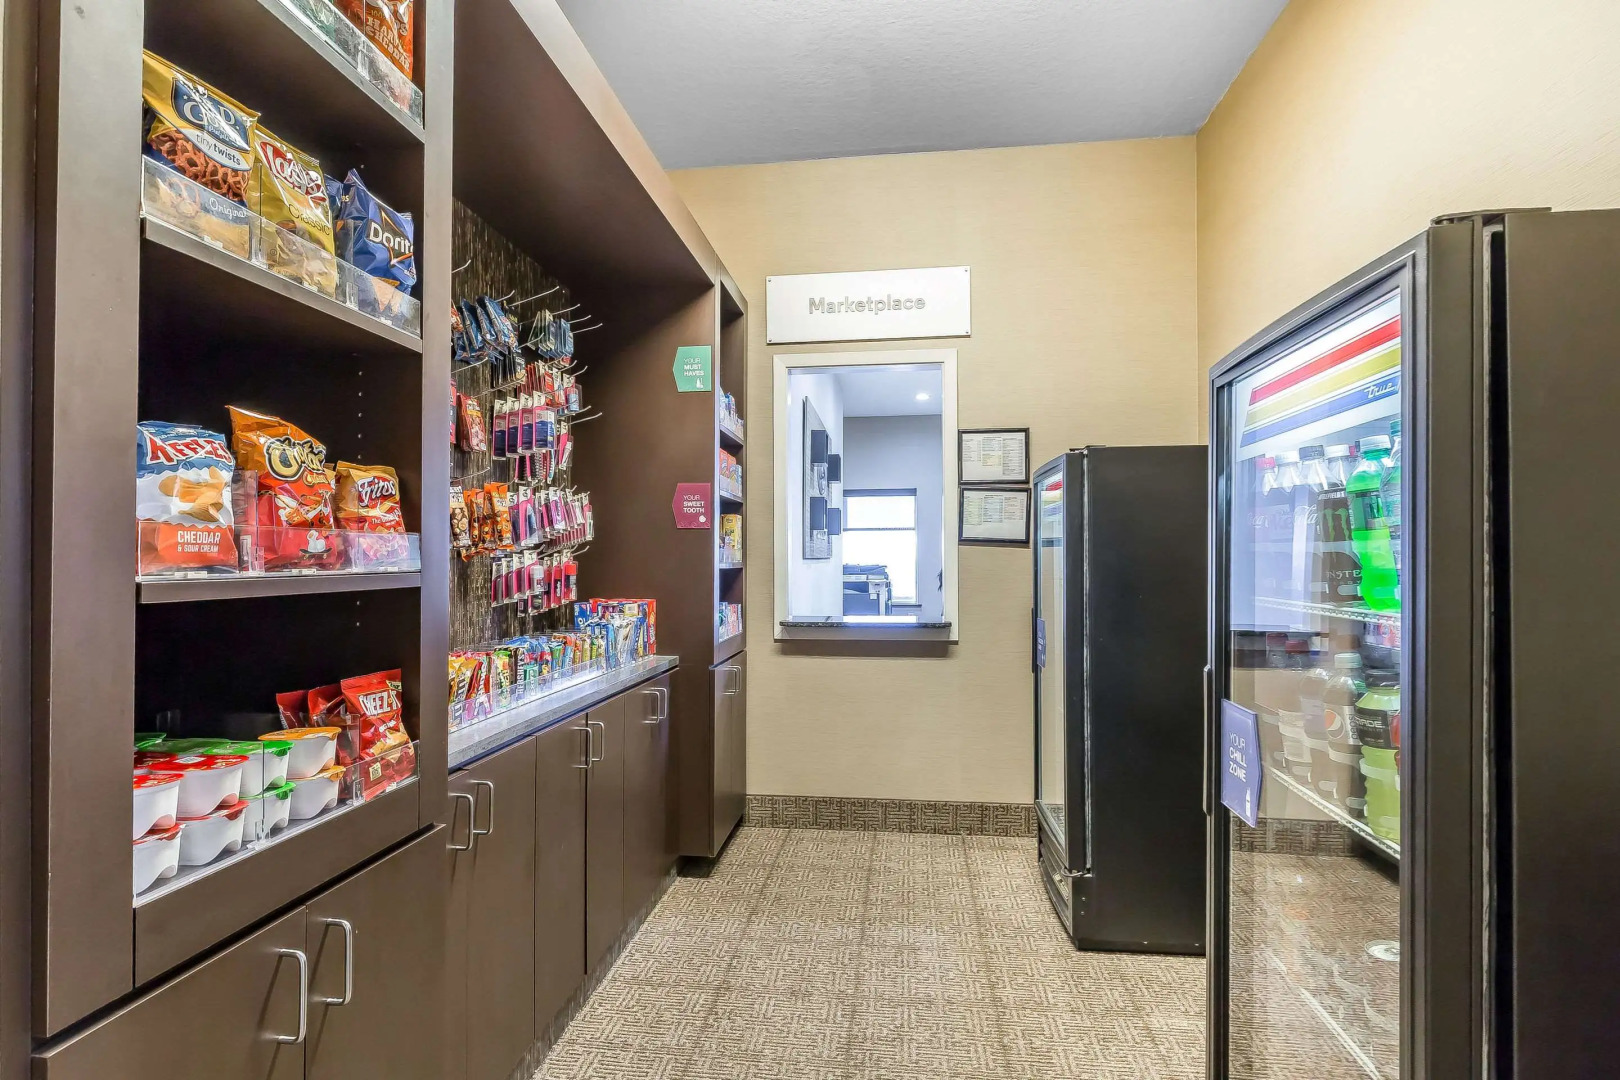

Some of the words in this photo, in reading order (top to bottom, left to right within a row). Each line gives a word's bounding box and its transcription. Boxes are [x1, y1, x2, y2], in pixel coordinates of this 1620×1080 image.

[196, 132, 213, 151] tiny
[213, 143, 241, 166] twists
[369, 221, 413, 253] Dorit
[808, 294, 926, 315] Marketplace
[149, 438, 233, 463] RFFLES
[358, 477, 396, 507] Fritos
[177, 530, 221, 543] CHEDDAR
[177, 544, 182, 552] &
[517, 654, 525, 694] HERSHEY'S
[1229, 732, 1246, 750] YOUR
[1229, 746, 1248, 767] CHILL
[1229, 760, 1247, 783] ZONE
